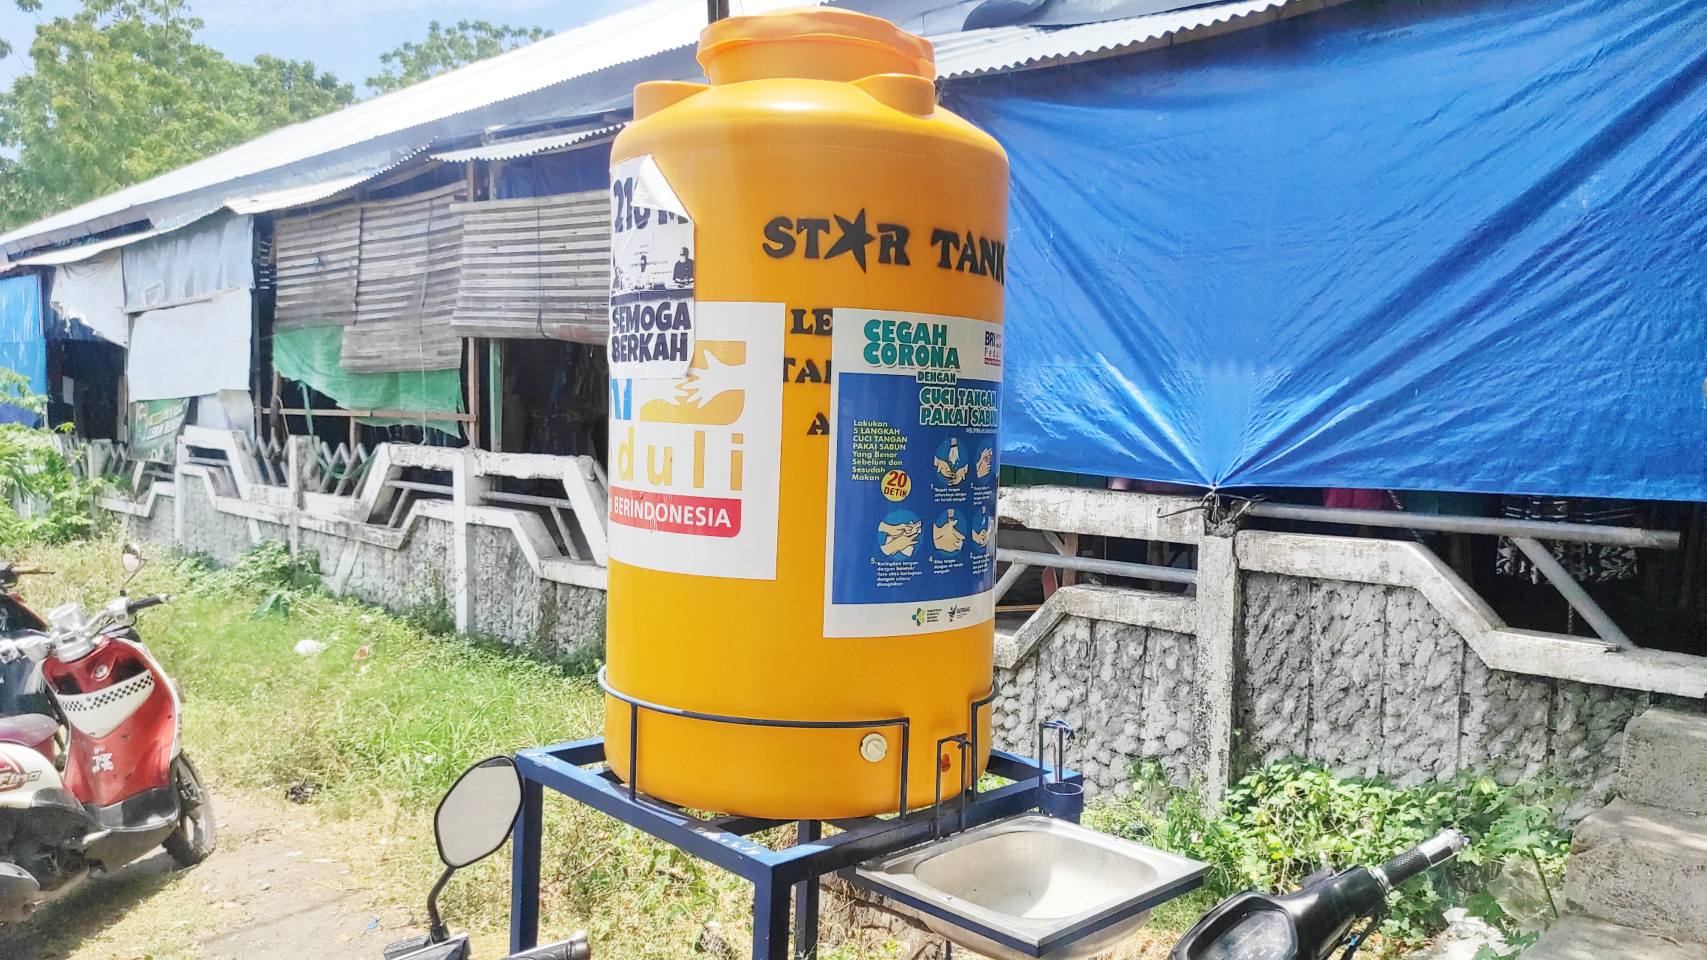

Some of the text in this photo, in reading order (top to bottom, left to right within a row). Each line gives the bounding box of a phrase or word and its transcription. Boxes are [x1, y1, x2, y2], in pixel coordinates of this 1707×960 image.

[612, 301, 692, 335] SEMOGA
[790, 308, 833, 336] LE
[863, 319, 948, 347] CEGAH
[611, 332, 689, 363] BERKAH
[862, 341, 961, 370] CORONA
[917, 370, 956, 384] DENGAN
[920, 387, 997, 409] CUCI TANGAN
[853, 419, 888, 427] Lakukan
[920, 406, 969, 426] PAKAI
[609, 426, 744, 492] duli
[852, 451, 873, 459] Yang
[879, 443, 906, 451] SABUN
[886, 470, 908, 488] 20
[614, 495, 733, 528] BERINDONESIA
